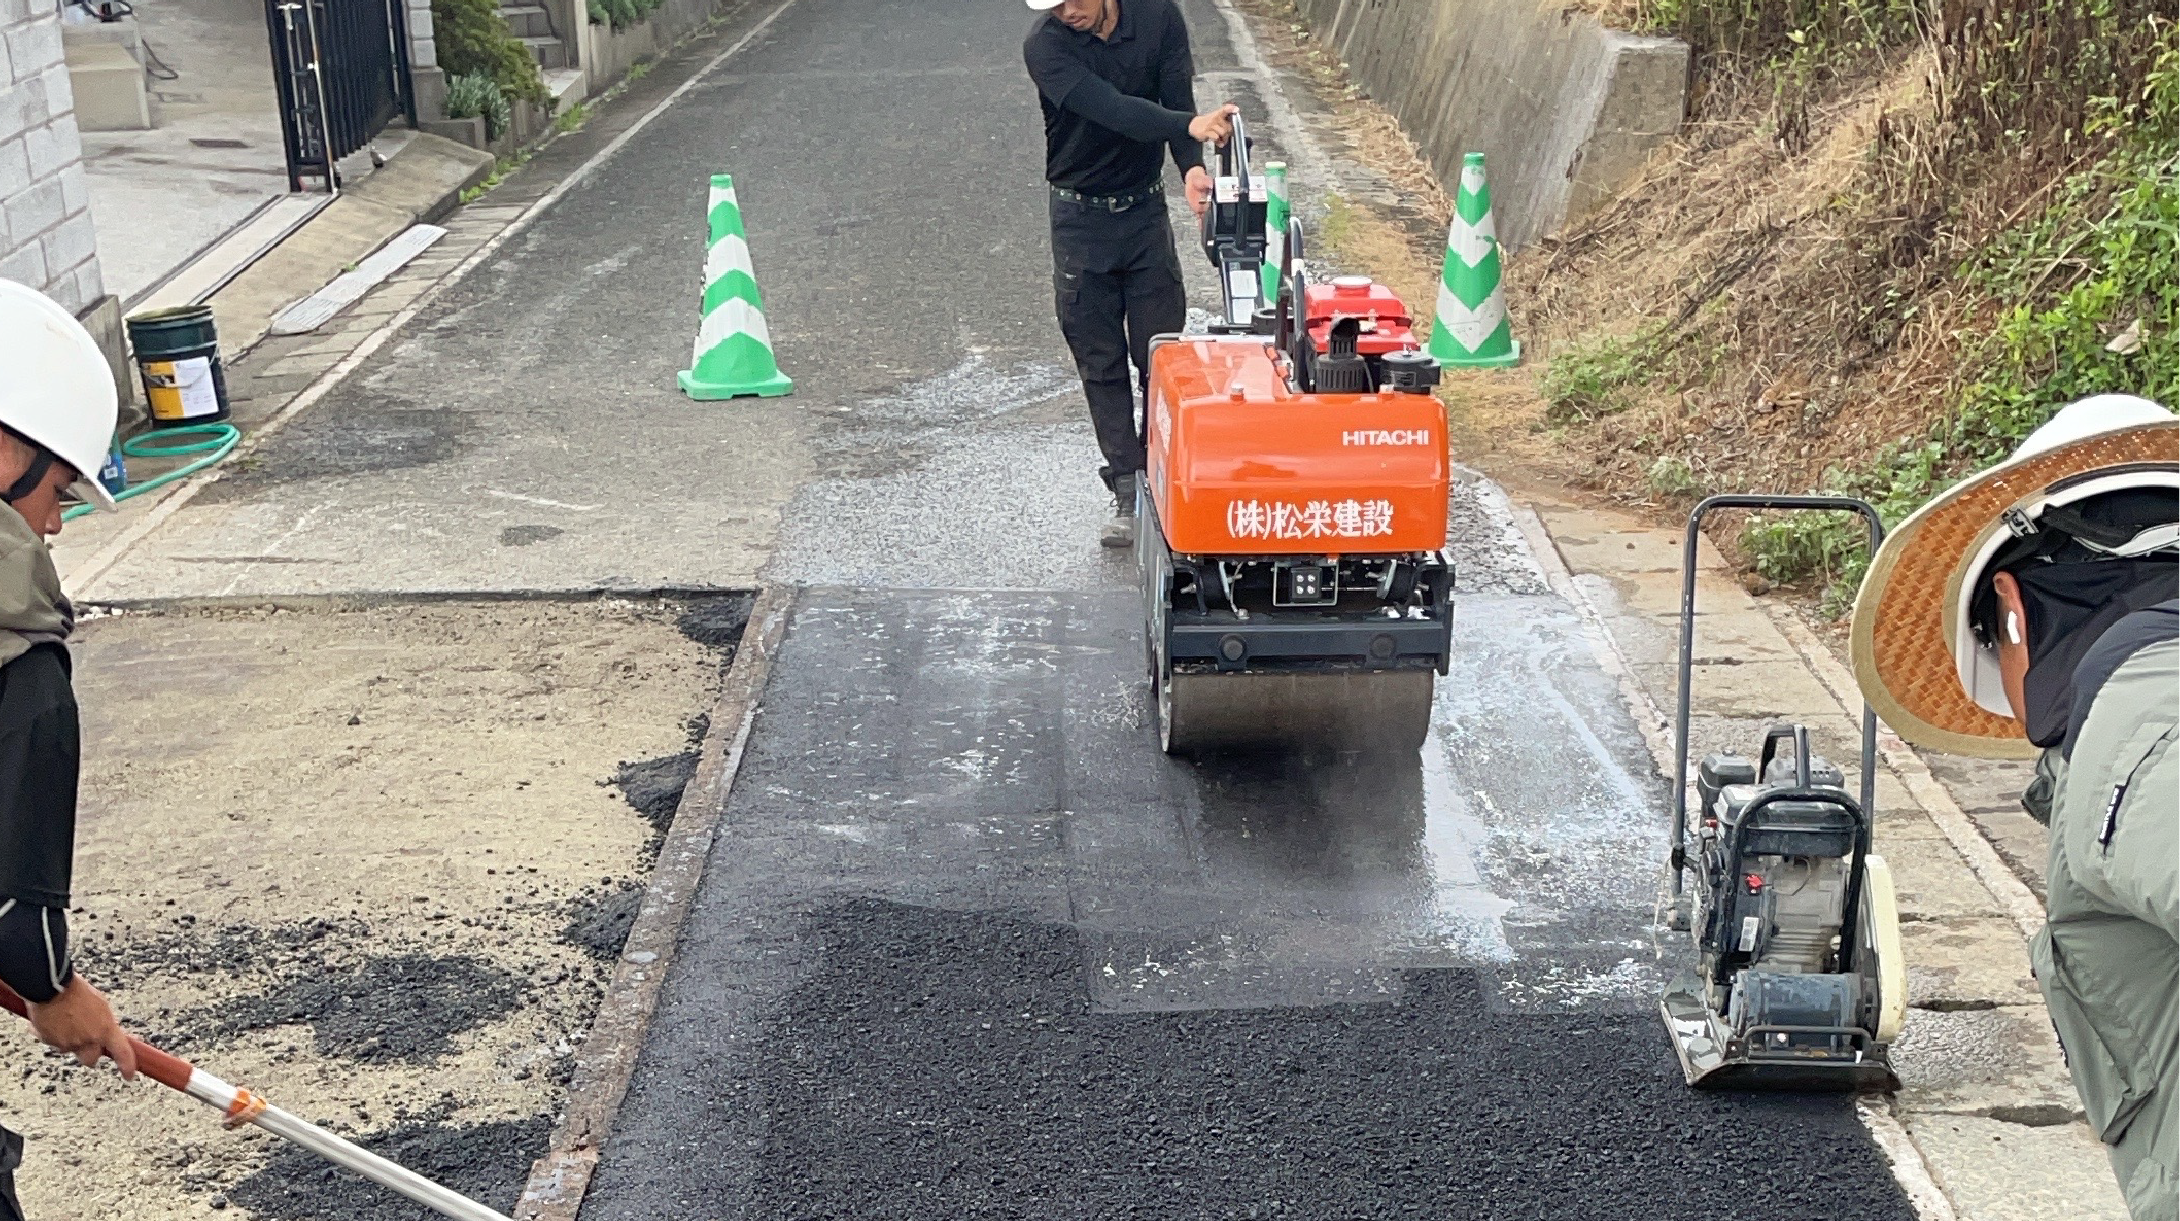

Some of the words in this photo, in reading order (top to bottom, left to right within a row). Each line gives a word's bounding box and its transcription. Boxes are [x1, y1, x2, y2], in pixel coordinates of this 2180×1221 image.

[1342, 429, 1429, 446] HITACHI
[1226, 499, 1394, 540] (株)松栄建設
